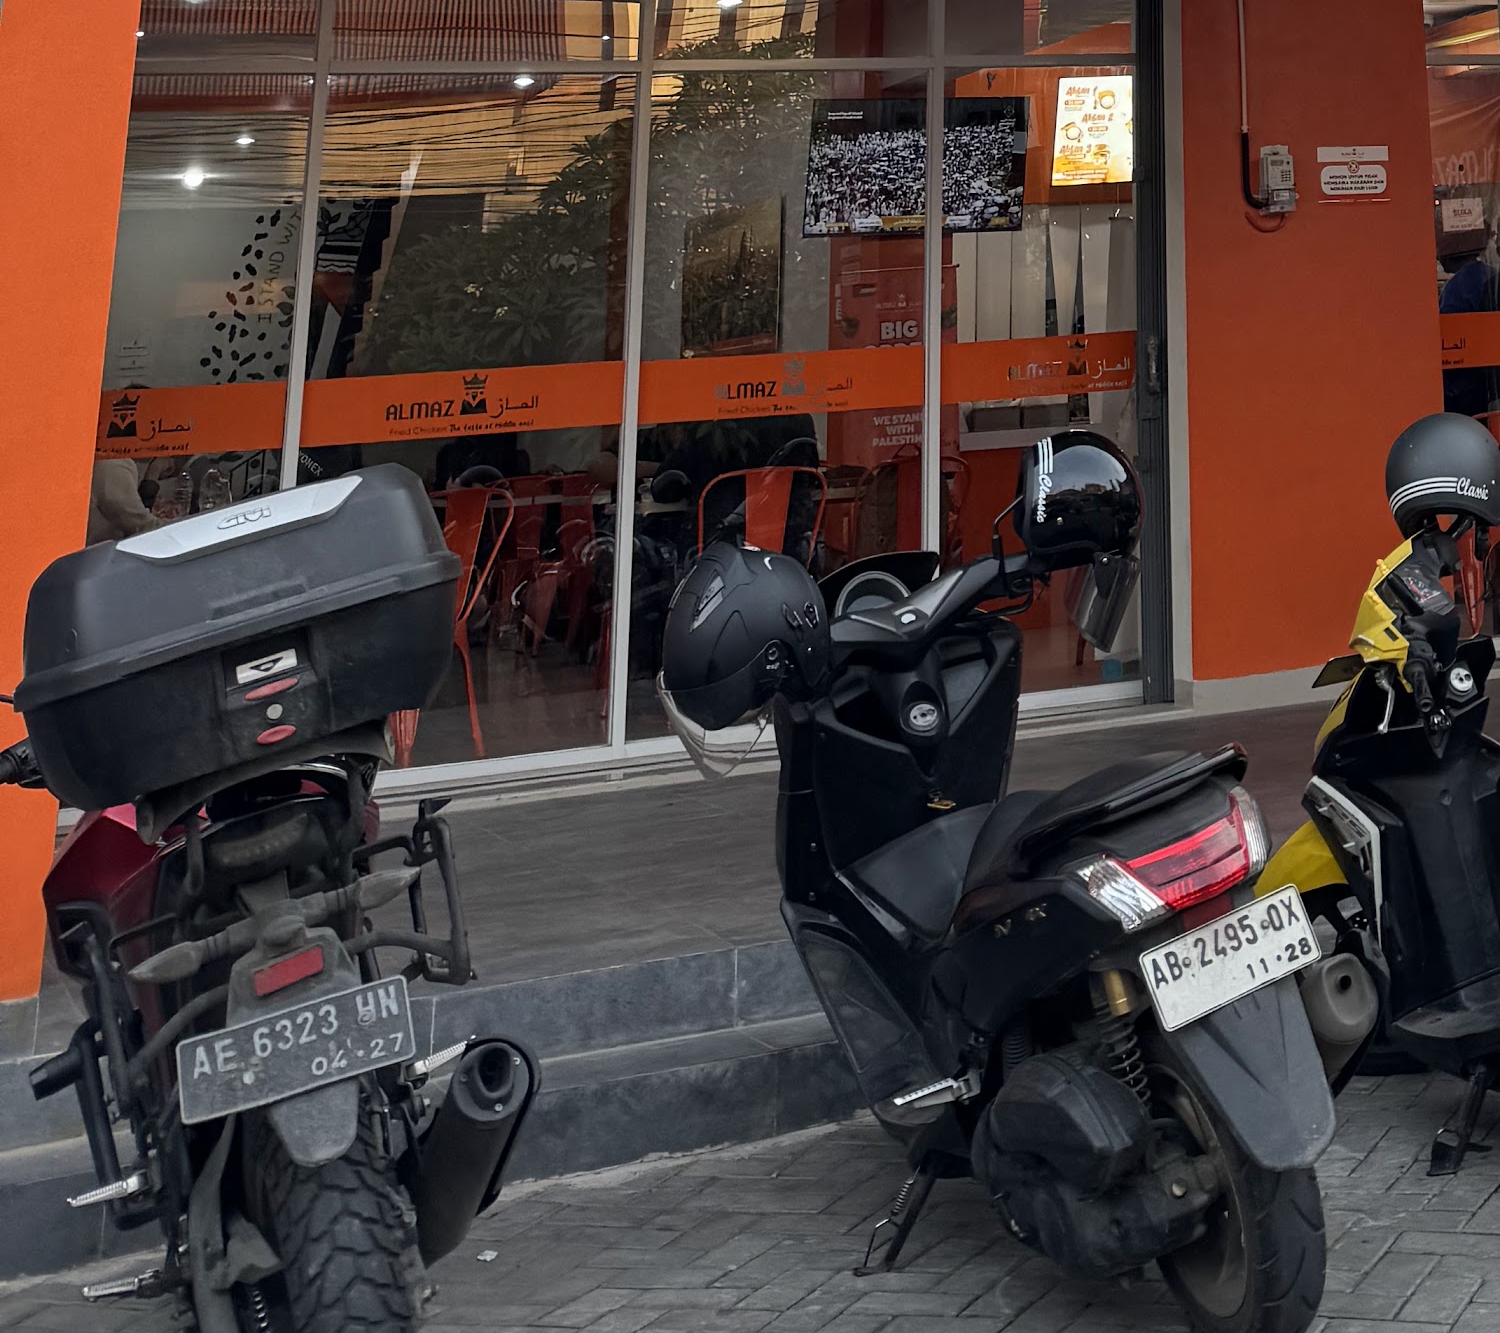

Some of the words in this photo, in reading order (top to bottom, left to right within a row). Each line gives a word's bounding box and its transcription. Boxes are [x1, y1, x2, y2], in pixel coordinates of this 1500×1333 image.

[258, 251, 285, 307] STAND
[880, 319, 919, 340] BIG
[1442, 337, 1466, 350] الما
[715, 381, 777, 400] ALMAZ
[386, 400, 455, 421] ALMAZ
[489, 395, 539, 418] الماز
[873, 415, 891, 426] WE
[891, 412, 923, 425] STAN
[885, 424, 914, 436] WITH
[872, 434, 923, 448] PALESTIN
[1037, 474, 1053, 523] Classic
[1457, 477, 1489, 501] Classic
[217, 507, 272, 530] GIVI
[1151, 950, 1184, 990] AB
[1193, 914, 1259, 968] 2495
[193, 1037, 237, 1080] AE
[252, 1003, 339, 1058] 6323
